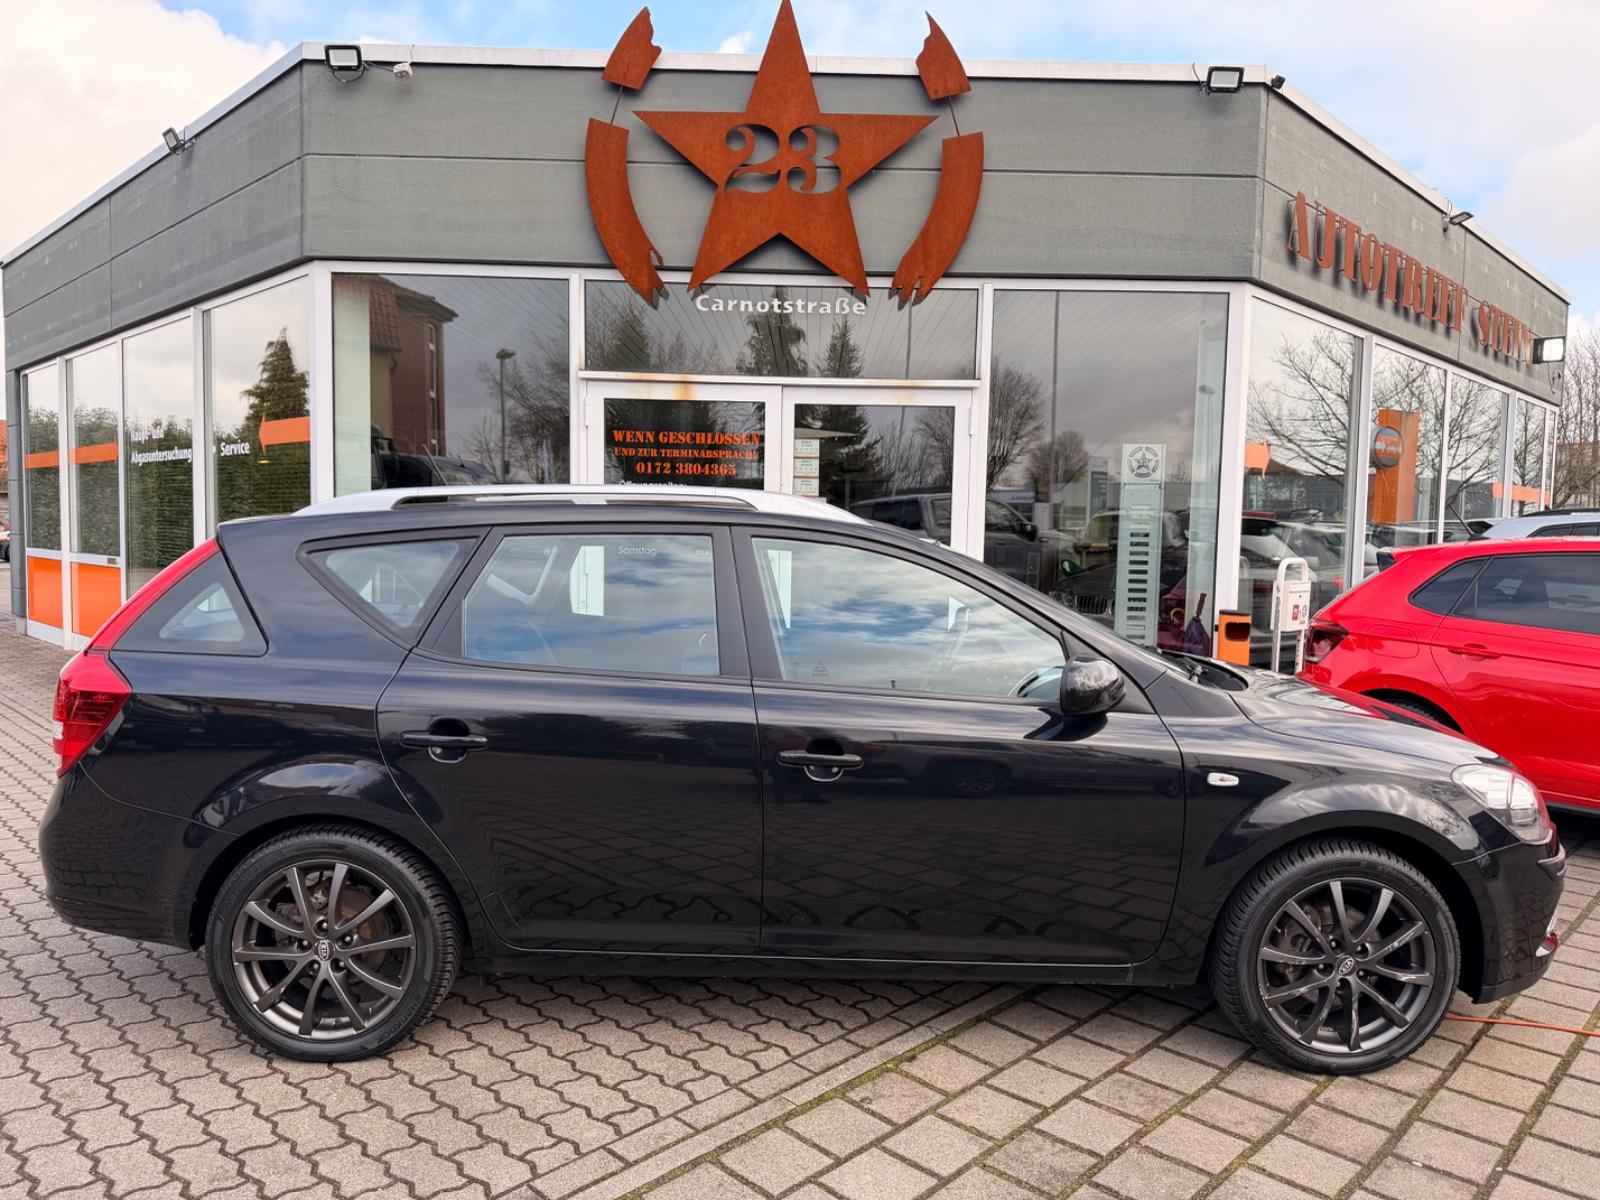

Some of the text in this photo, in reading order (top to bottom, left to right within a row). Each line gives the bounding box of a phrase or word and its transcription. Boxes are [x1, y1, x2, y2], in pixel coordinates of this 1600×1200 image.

[724, 123, 841, 195] 23
[695, 294, 867, 316] Carnotstraße
[612, 430, 760, 446] WENN GESCHLOSSEN
[220, 439, 250, 456] Service
[614, 447, 760, 460] UND ZUR TERMINABSPRACHE
[131, 446, 193, 466] Abgasuntersuchung
[635, 461, 737, 476] 0172 3804365
[616, 546, 657, 557] Samstag
